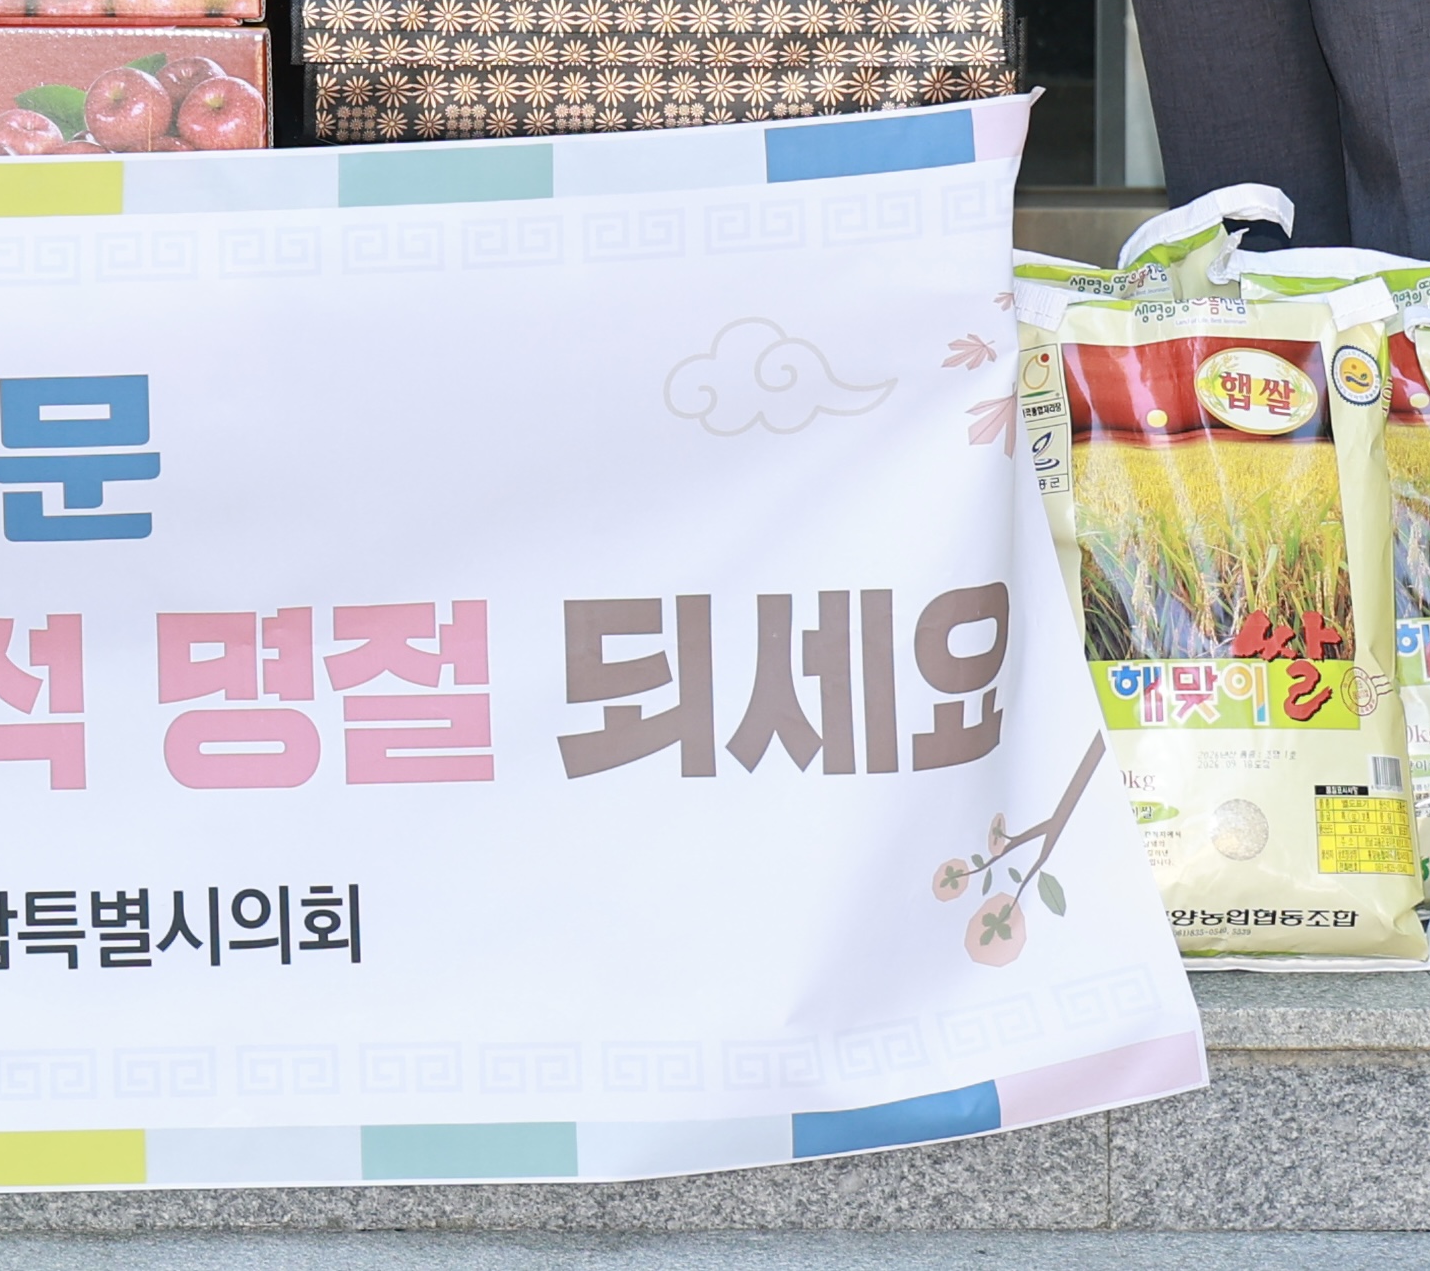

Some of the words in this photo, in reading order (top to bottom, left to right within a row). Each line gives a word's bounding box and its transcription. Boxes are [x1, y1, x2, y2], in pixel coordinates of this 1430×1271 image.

[1220, 372, 1296, 418] 햅쌀
[155, 598, 498, 792] 명절
[557, 580, 1012, 782] 되세요
[1110, 660, 1267, 727] 해맞이
[1231, 609, 1342, 721] 쌀
[1165, 909, 1359, 928] 양농업협동조합
